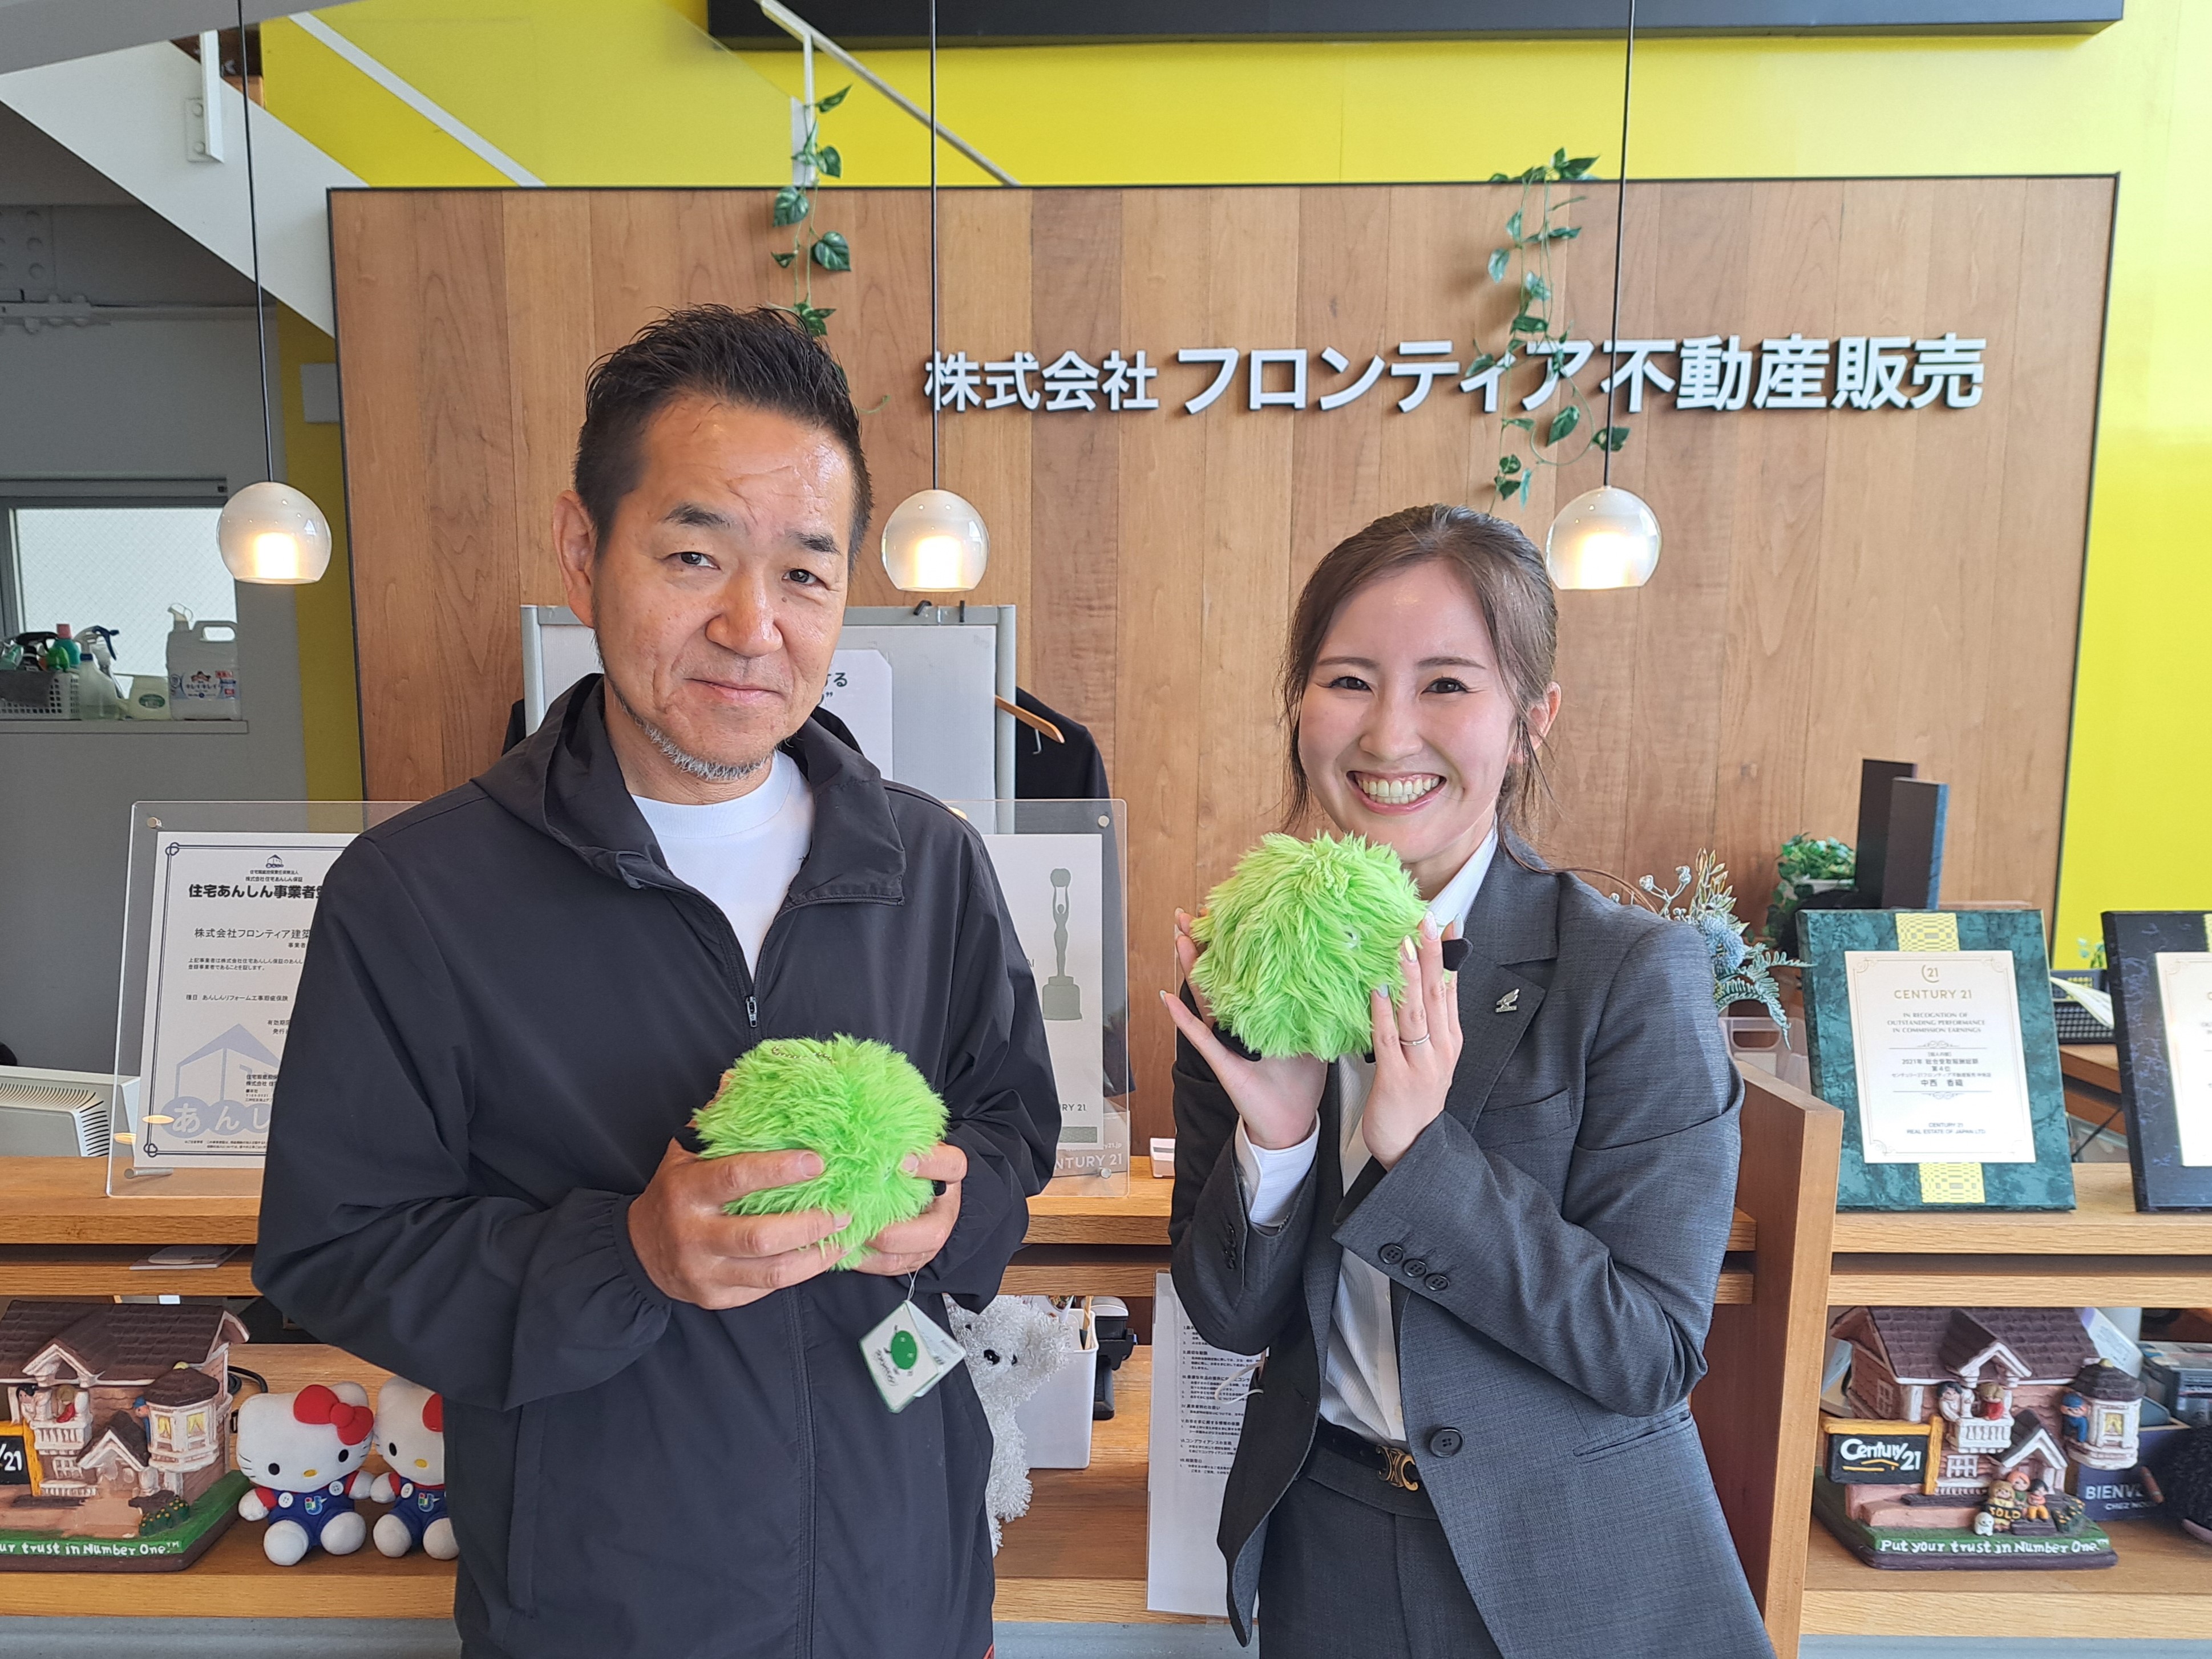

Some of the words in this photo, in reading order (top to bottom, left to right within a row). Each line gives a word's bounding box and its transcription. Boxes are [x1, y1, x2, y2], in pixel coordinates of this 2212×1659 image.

[924, 350, 1159, 411] 株式会社
[1178, 332, 1987, 415] フロンティア不動産販売
[1894, 989, 1956, 999] CENTURY
[1960, 989, 1972, 999] 21
[1109, 1153, 1122, 1166] 21
[1840, 1438, 1908, 1460] Century
[1900, 1451, 1922, 1471] 21
[1989, 1507, 2021, 1520] SOLD
[21, 1542, 60, 1553] trust
[66, 1543, 80, 1555] in
[83, 1543, 136, 1556] Number
[1880, 1539, 1908, 1553] Put
[1911, 1541, 1944, 1553] your
[1951, 1541, 1992, 1553] trust
[1993, 1539, 2011, 1553] in
[2013, 1540, 2068, 1553] Number
